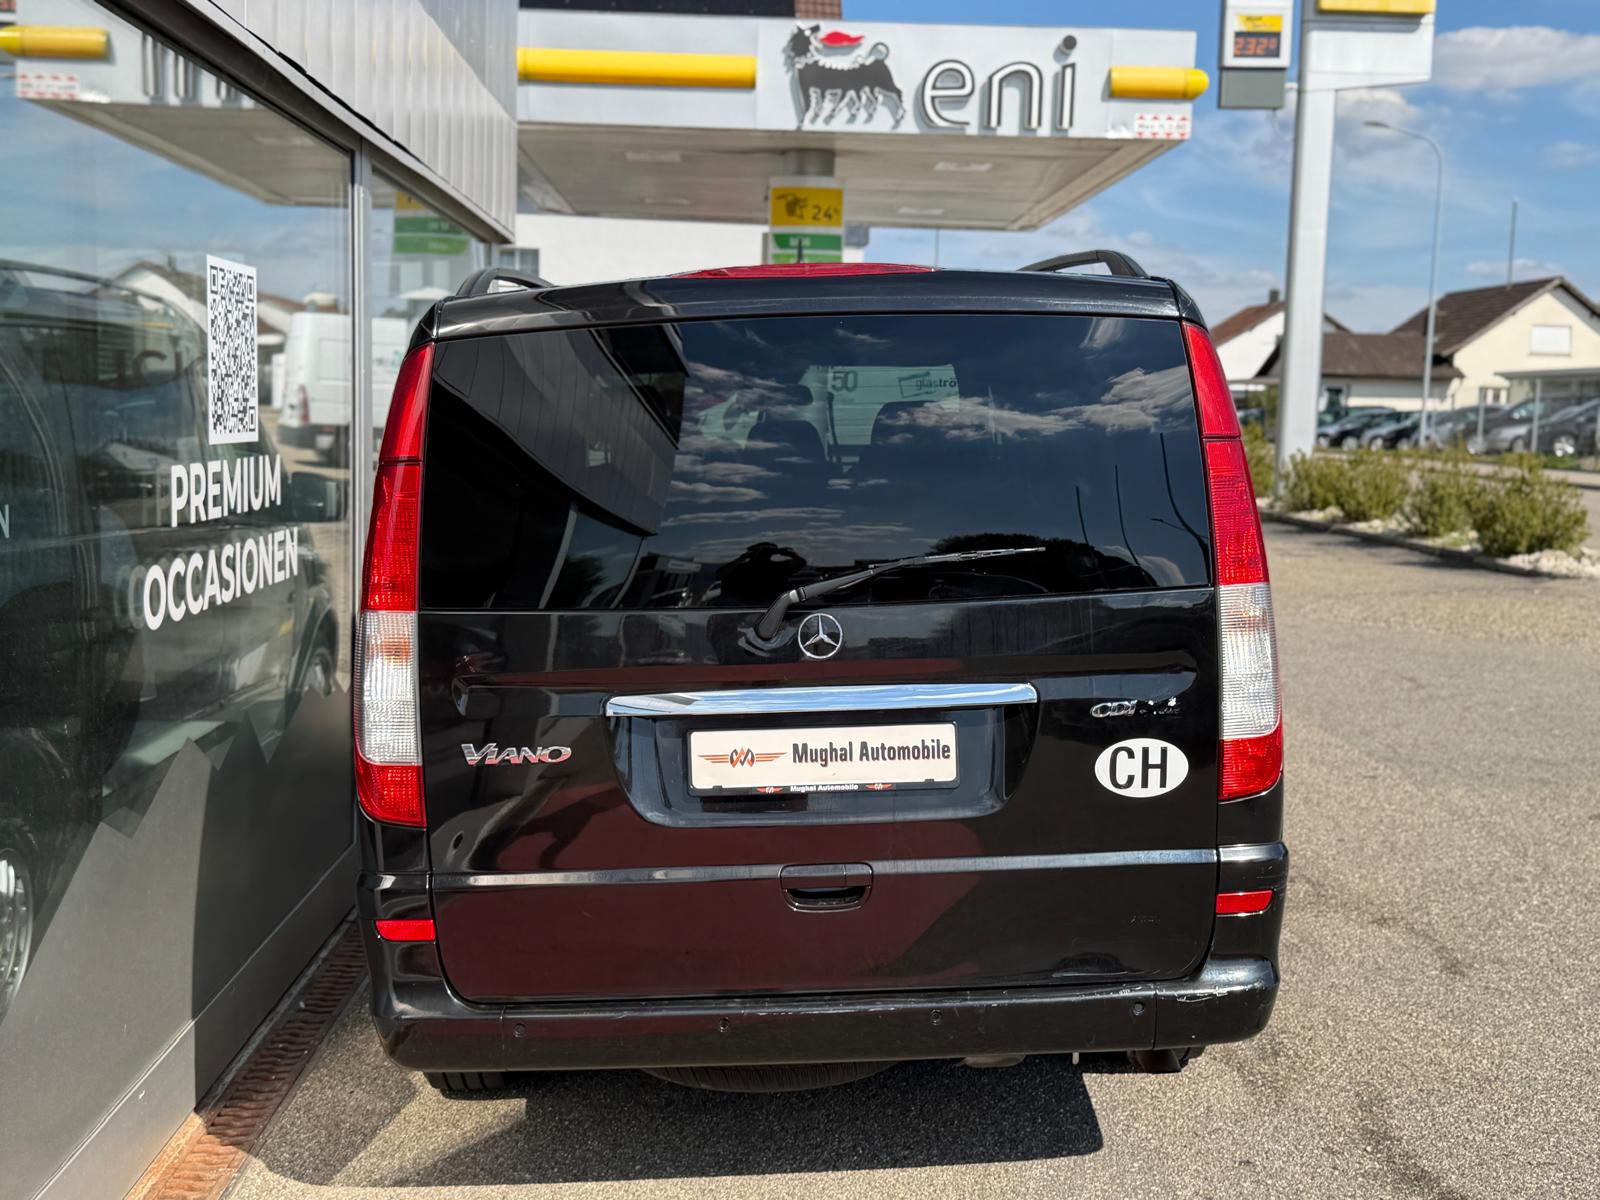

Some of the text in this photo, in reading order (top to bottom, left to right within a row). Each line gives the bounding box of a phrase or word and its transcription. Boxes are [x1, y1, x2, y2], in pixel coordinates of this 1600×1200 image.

[921, 34, 1078, 129] eni
[171, 454, 282, 528] PREMIUM
[143, 526, 299, 631] OCCASIONEN
[792, 738, 951, 768] Mughal Automobile
[1109, 746, 1169, 790] CH
